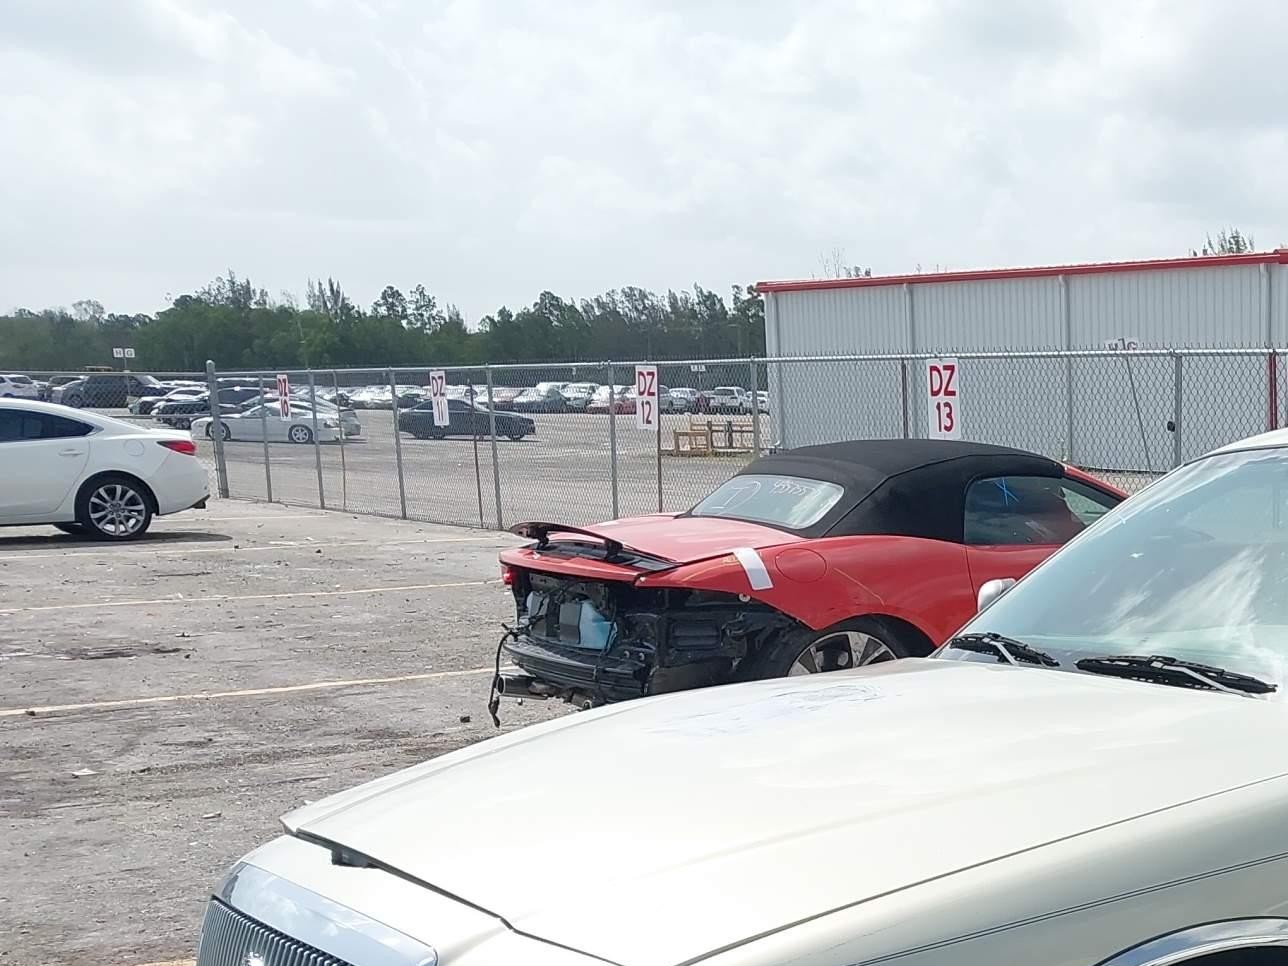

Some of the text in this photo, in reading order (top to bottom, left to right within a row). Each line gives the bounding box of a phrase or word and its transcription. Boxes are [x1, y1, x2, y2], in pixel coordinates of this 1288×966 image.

[277, 378, 288, 397] DZ
[431, 375, 446, 397] DZ
[637, 371, 656, 397] DZ
[929, 364, 957, 397] DZ
[436, 400, 444, 421] 11
[641, 400, 652, 425] 12
[935, 401, 954, 433] 13
